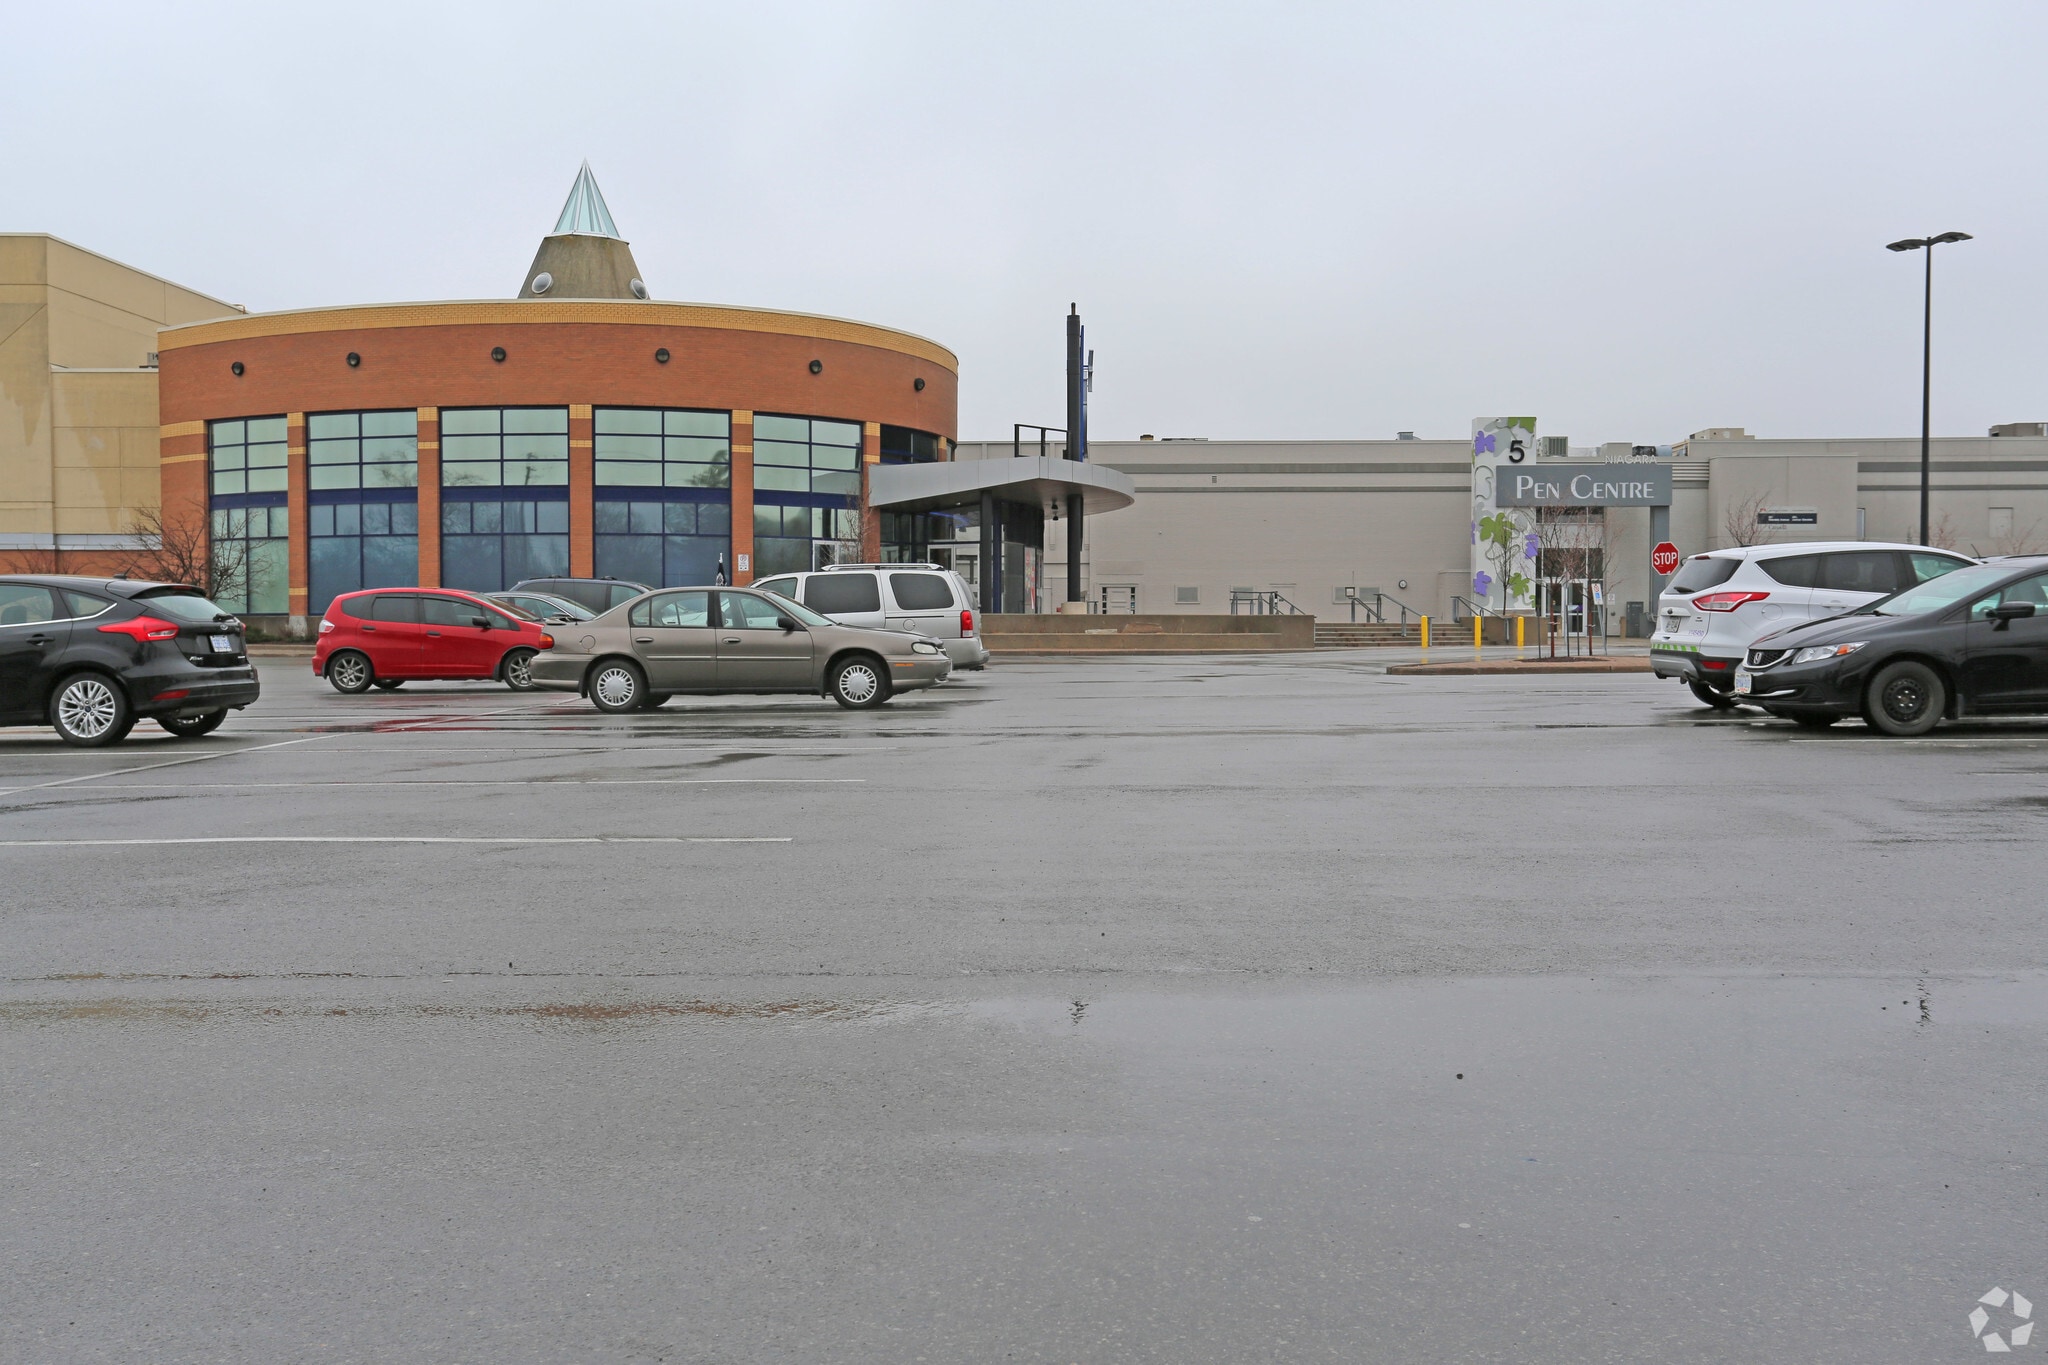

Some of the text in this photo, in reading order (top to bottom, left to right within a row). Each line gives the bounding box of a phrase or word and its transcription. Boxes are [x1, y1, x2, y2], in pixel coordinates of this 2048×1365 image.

[1508, 440, 1525, 463] 5
[1604, 455, 1659, 464] NIAGARA
[1516, 474, 1655, 499] PEN CENTRE
[1654, 552, 1677, 565] STOP
